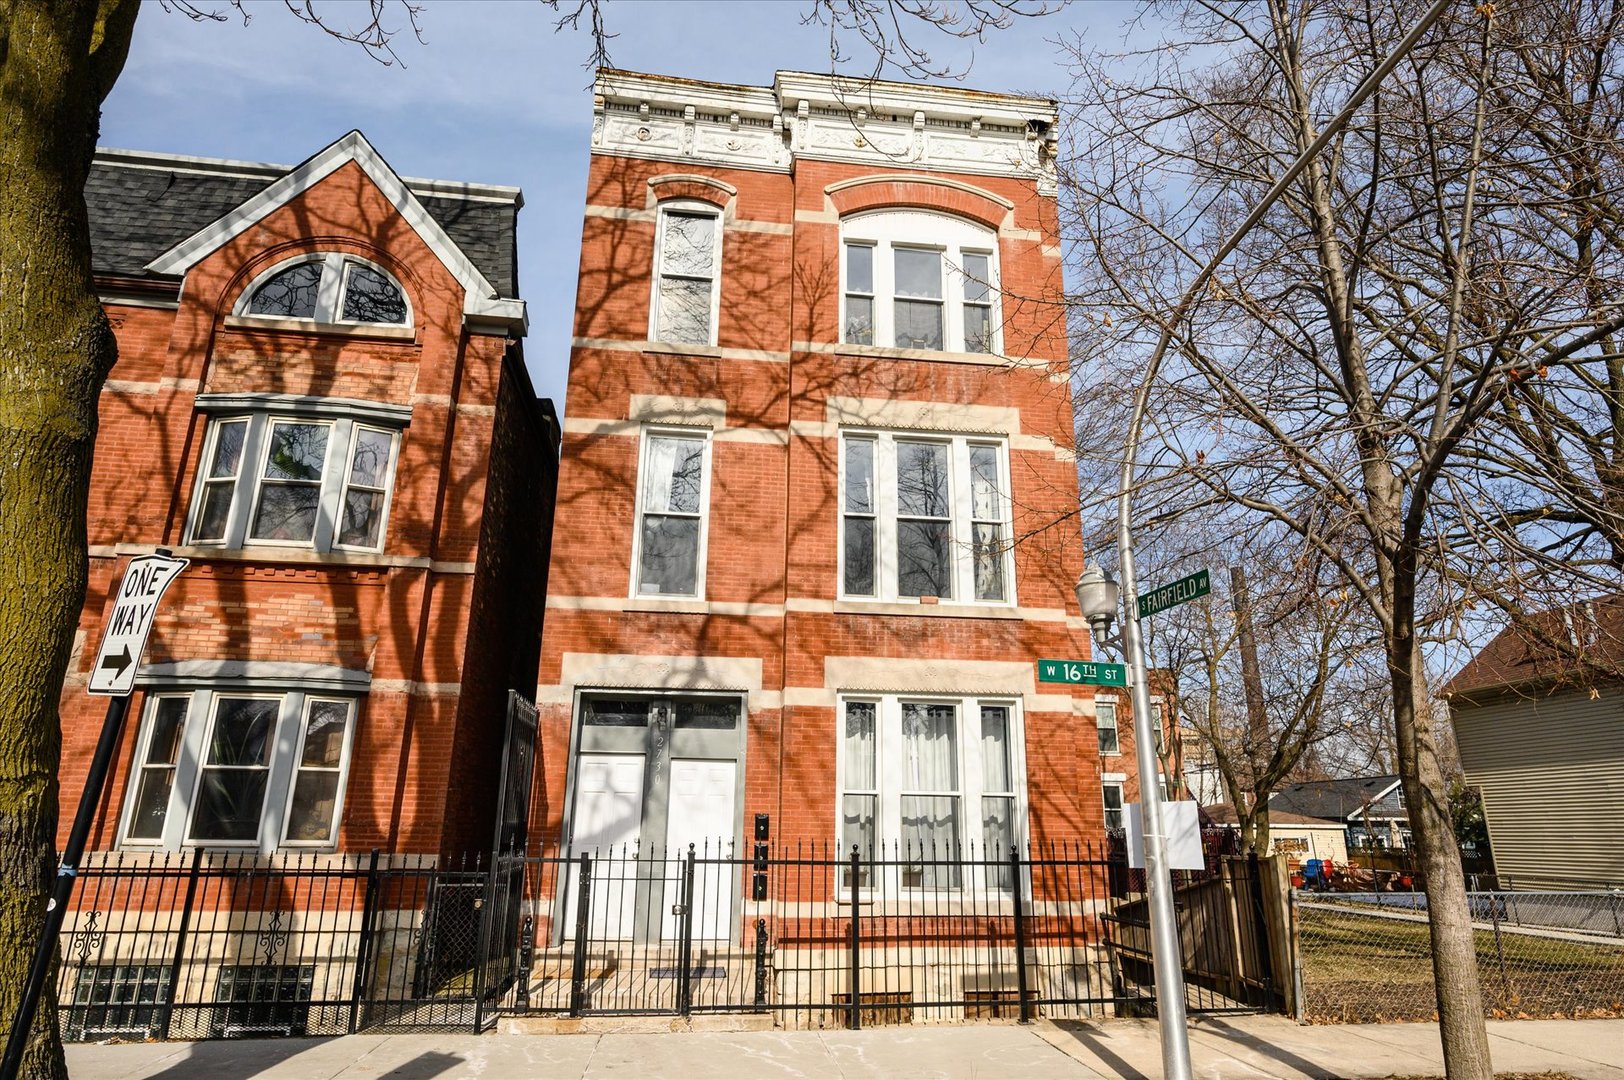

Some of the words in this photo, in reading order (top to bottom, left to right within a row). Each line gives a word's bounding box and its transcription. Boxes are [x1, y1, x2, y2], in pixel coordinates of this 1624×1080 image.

[124, 566, 170, 598] ONE
[1141, 600, 1146, 611] S
[1147, 578, 1197, 613] FAIRFIELD
[1199, 576, 1207, 590] AV
[111, 603, 152, 636] WAY
[1046, 665, 1056, 677] W
[1063, 663, 1097, 681] 16TH
[1104, 669, 1118, 680] ST
[654, 736, 664, 785] 2730
